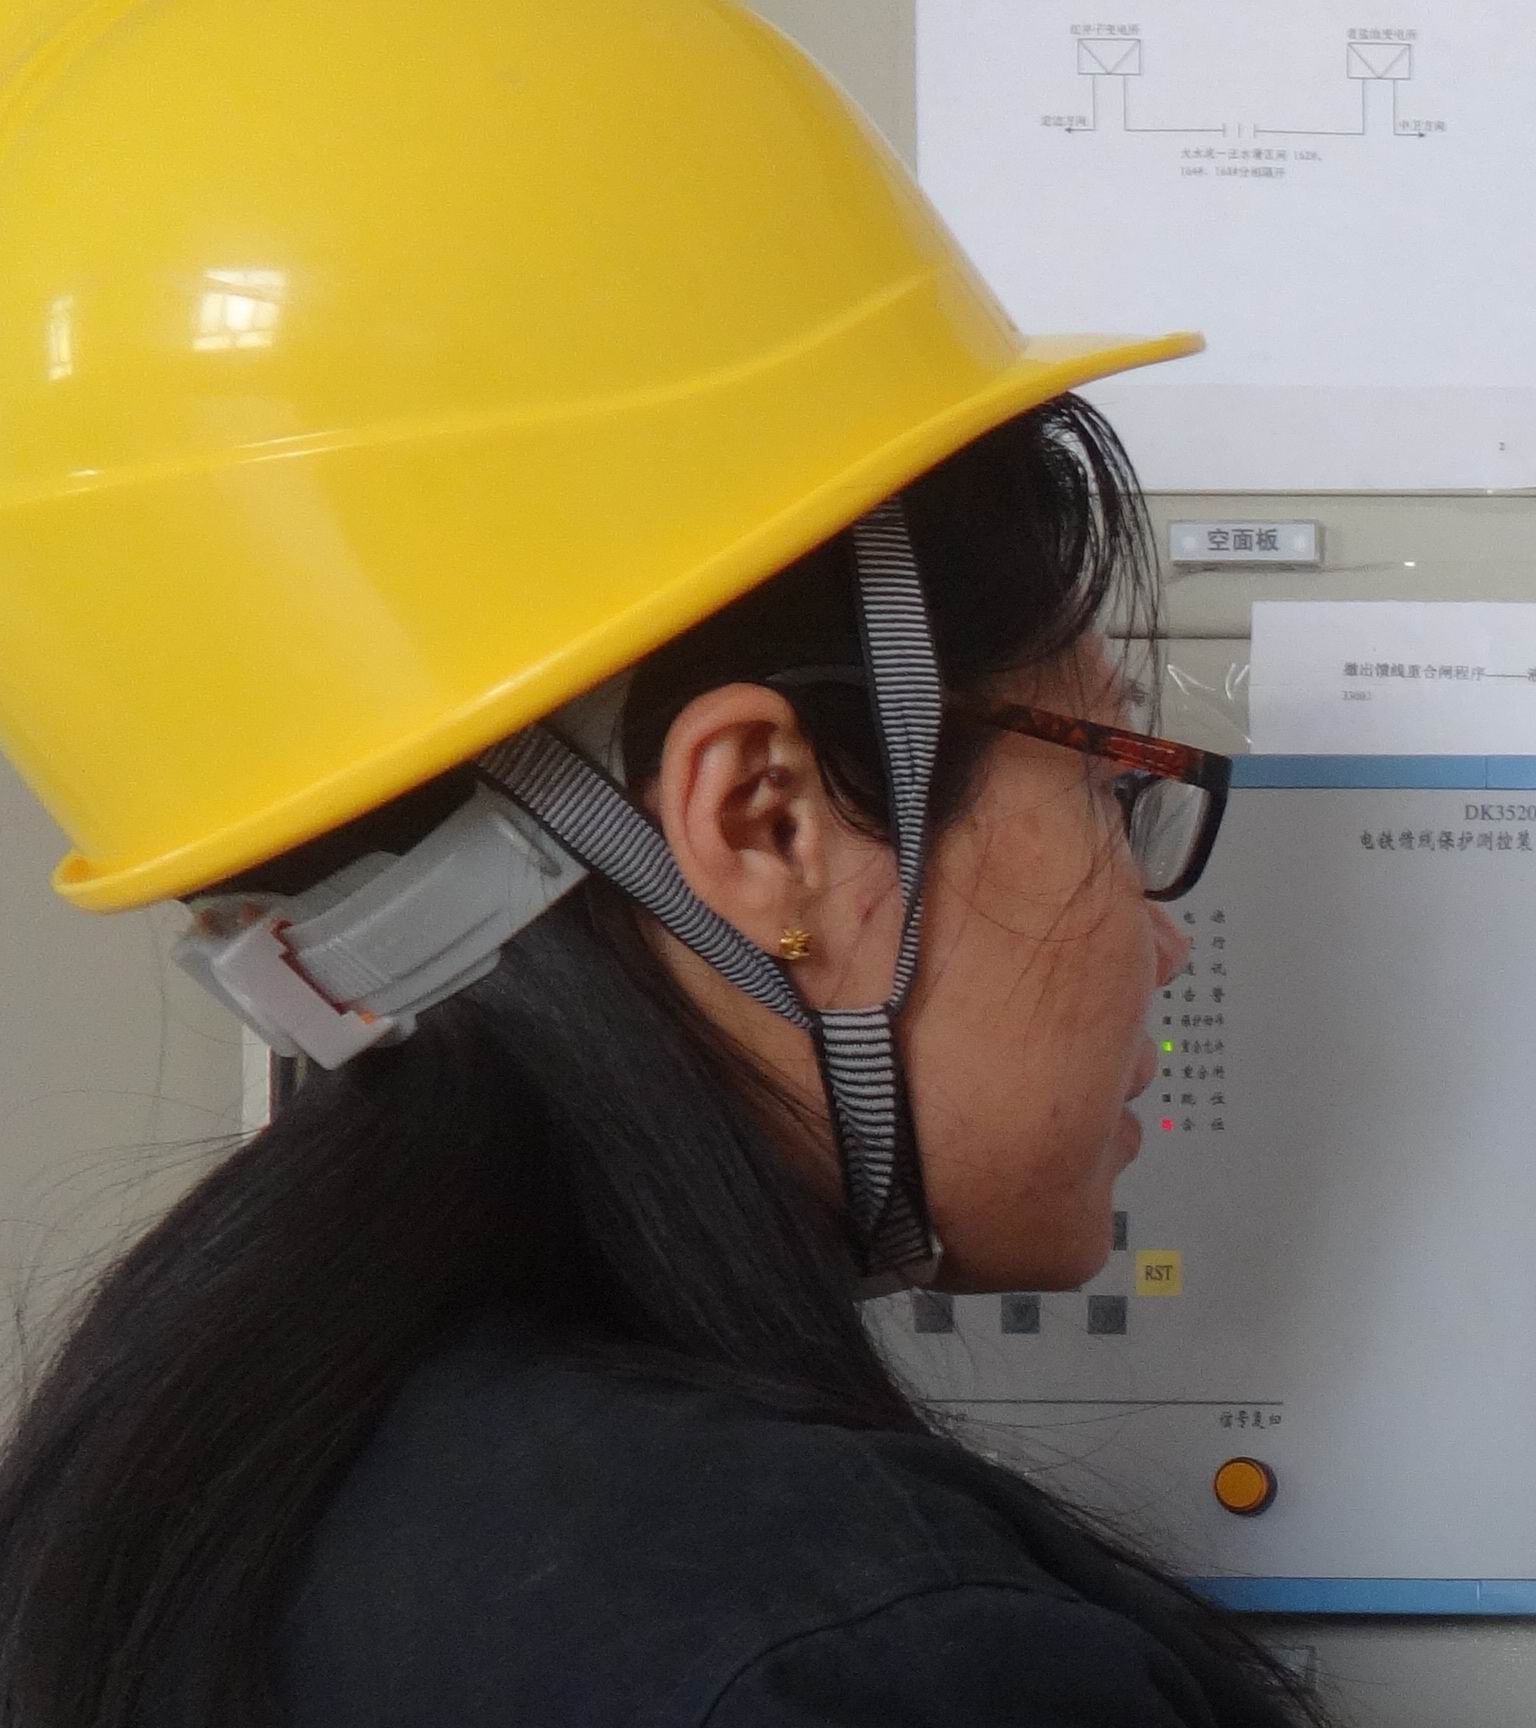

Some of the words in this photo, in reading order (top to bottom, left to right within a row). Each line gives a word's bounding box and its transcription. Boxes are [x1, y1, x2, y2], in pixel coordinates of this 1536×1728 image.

[1206, 527, 1281, 553] 空面板
[1143, 1264, 1174, 1283] RST
